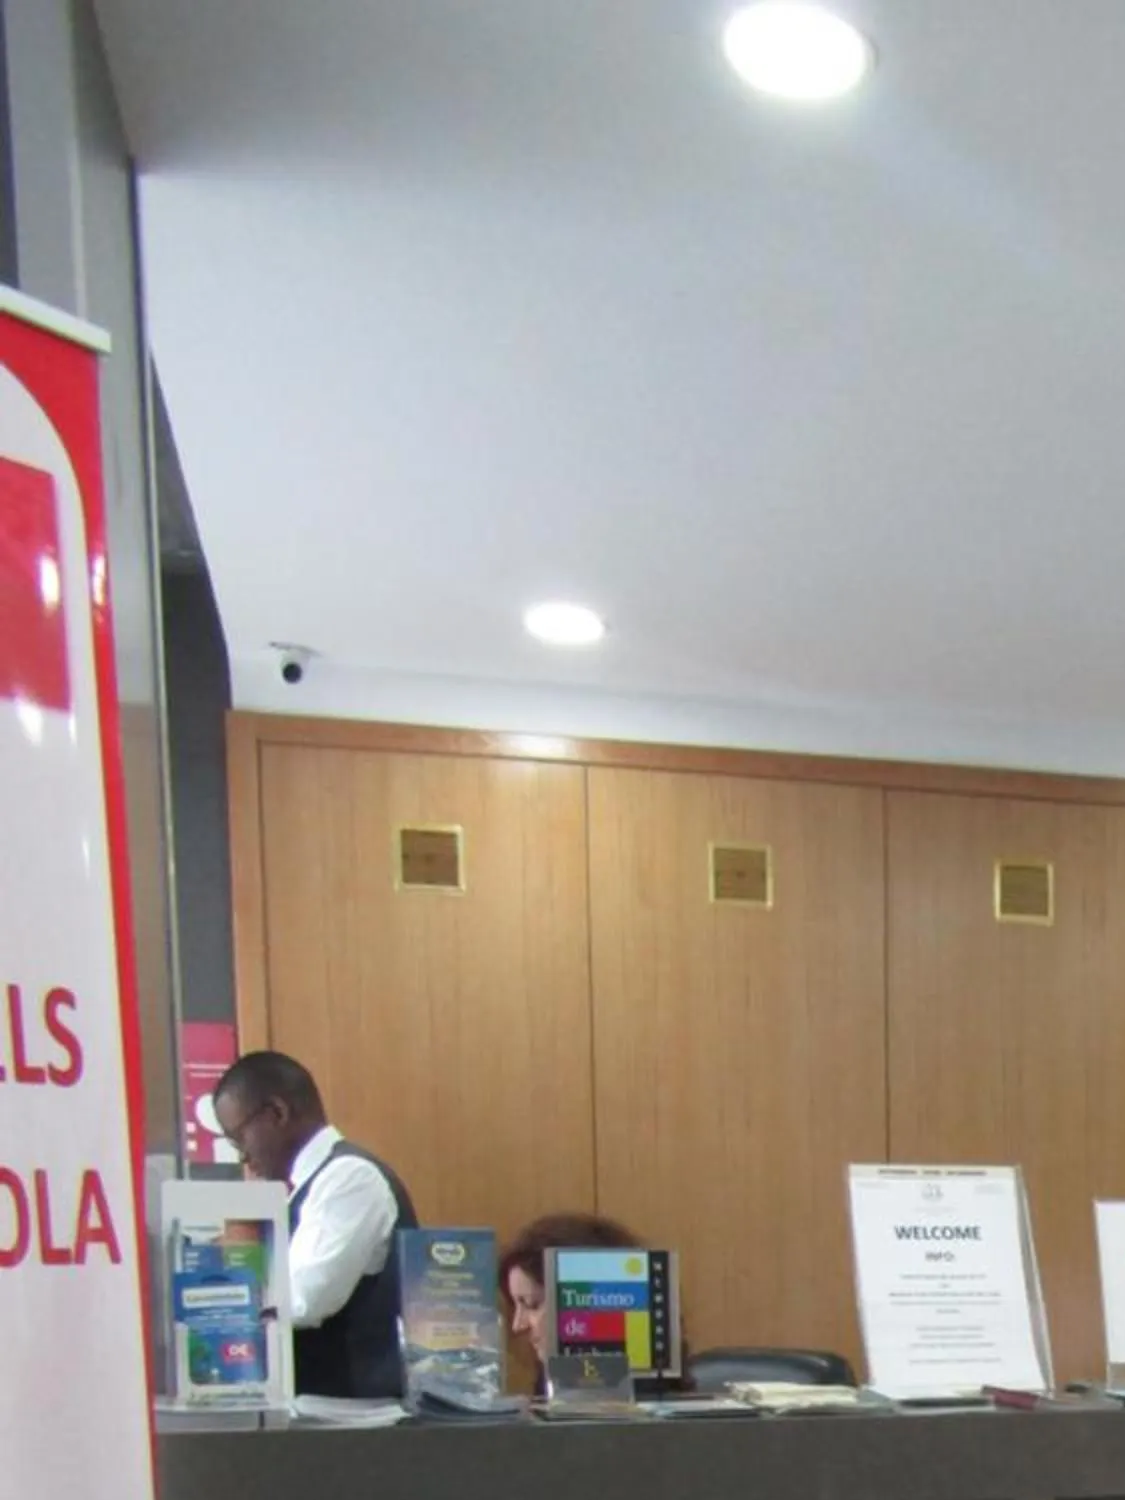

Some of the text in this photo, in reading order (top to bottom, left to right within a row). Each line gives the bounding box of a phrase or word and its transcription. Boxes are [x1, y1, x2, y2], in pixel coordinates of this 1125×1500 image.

[0, 984, 83, 1088] LS
[894, 1225, 982, 1241] WELCOME
[562, 1288, 635, 1307] Turismo
[565, 1318, 588, 1336] de
